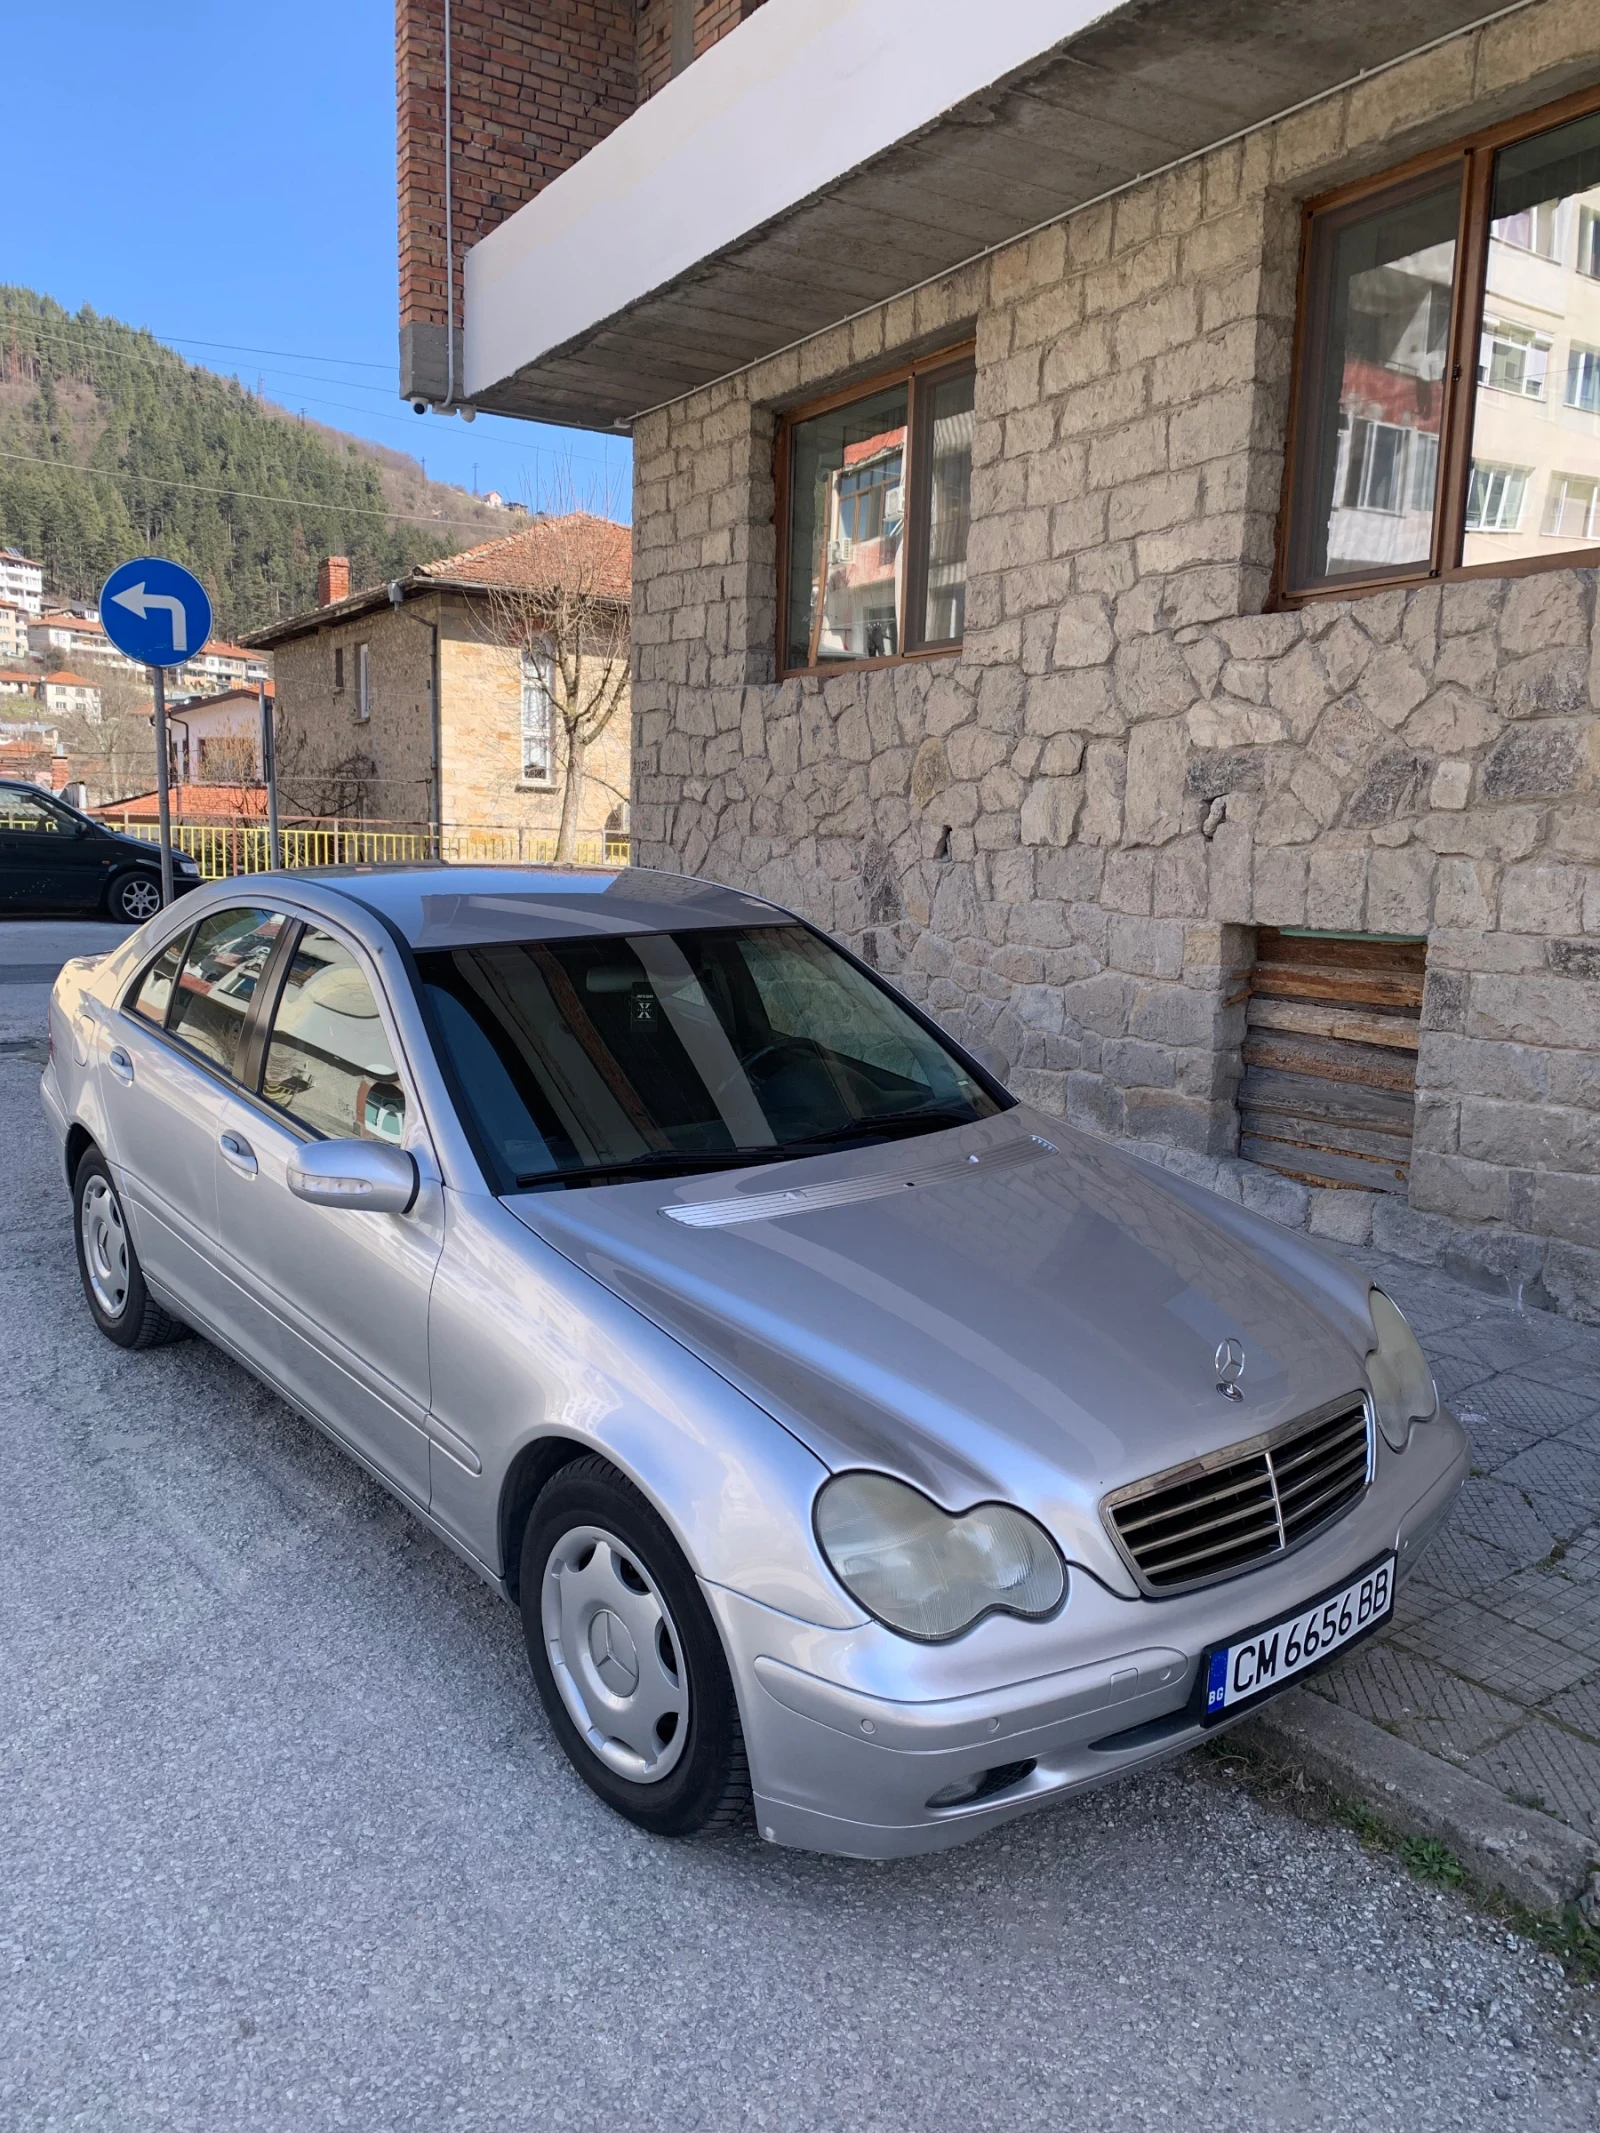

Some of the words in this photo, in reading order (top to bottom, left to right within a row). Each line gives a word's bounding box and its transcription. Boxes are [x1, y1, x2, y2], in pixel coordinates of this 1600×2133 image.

[1233, 1633, 1279, 1692] CM
[1284, 1592, 1352, 1667] 6656
[1357, 1568, 1388, 1625] BB
[1208, 1687, 1224, 1705] BG
